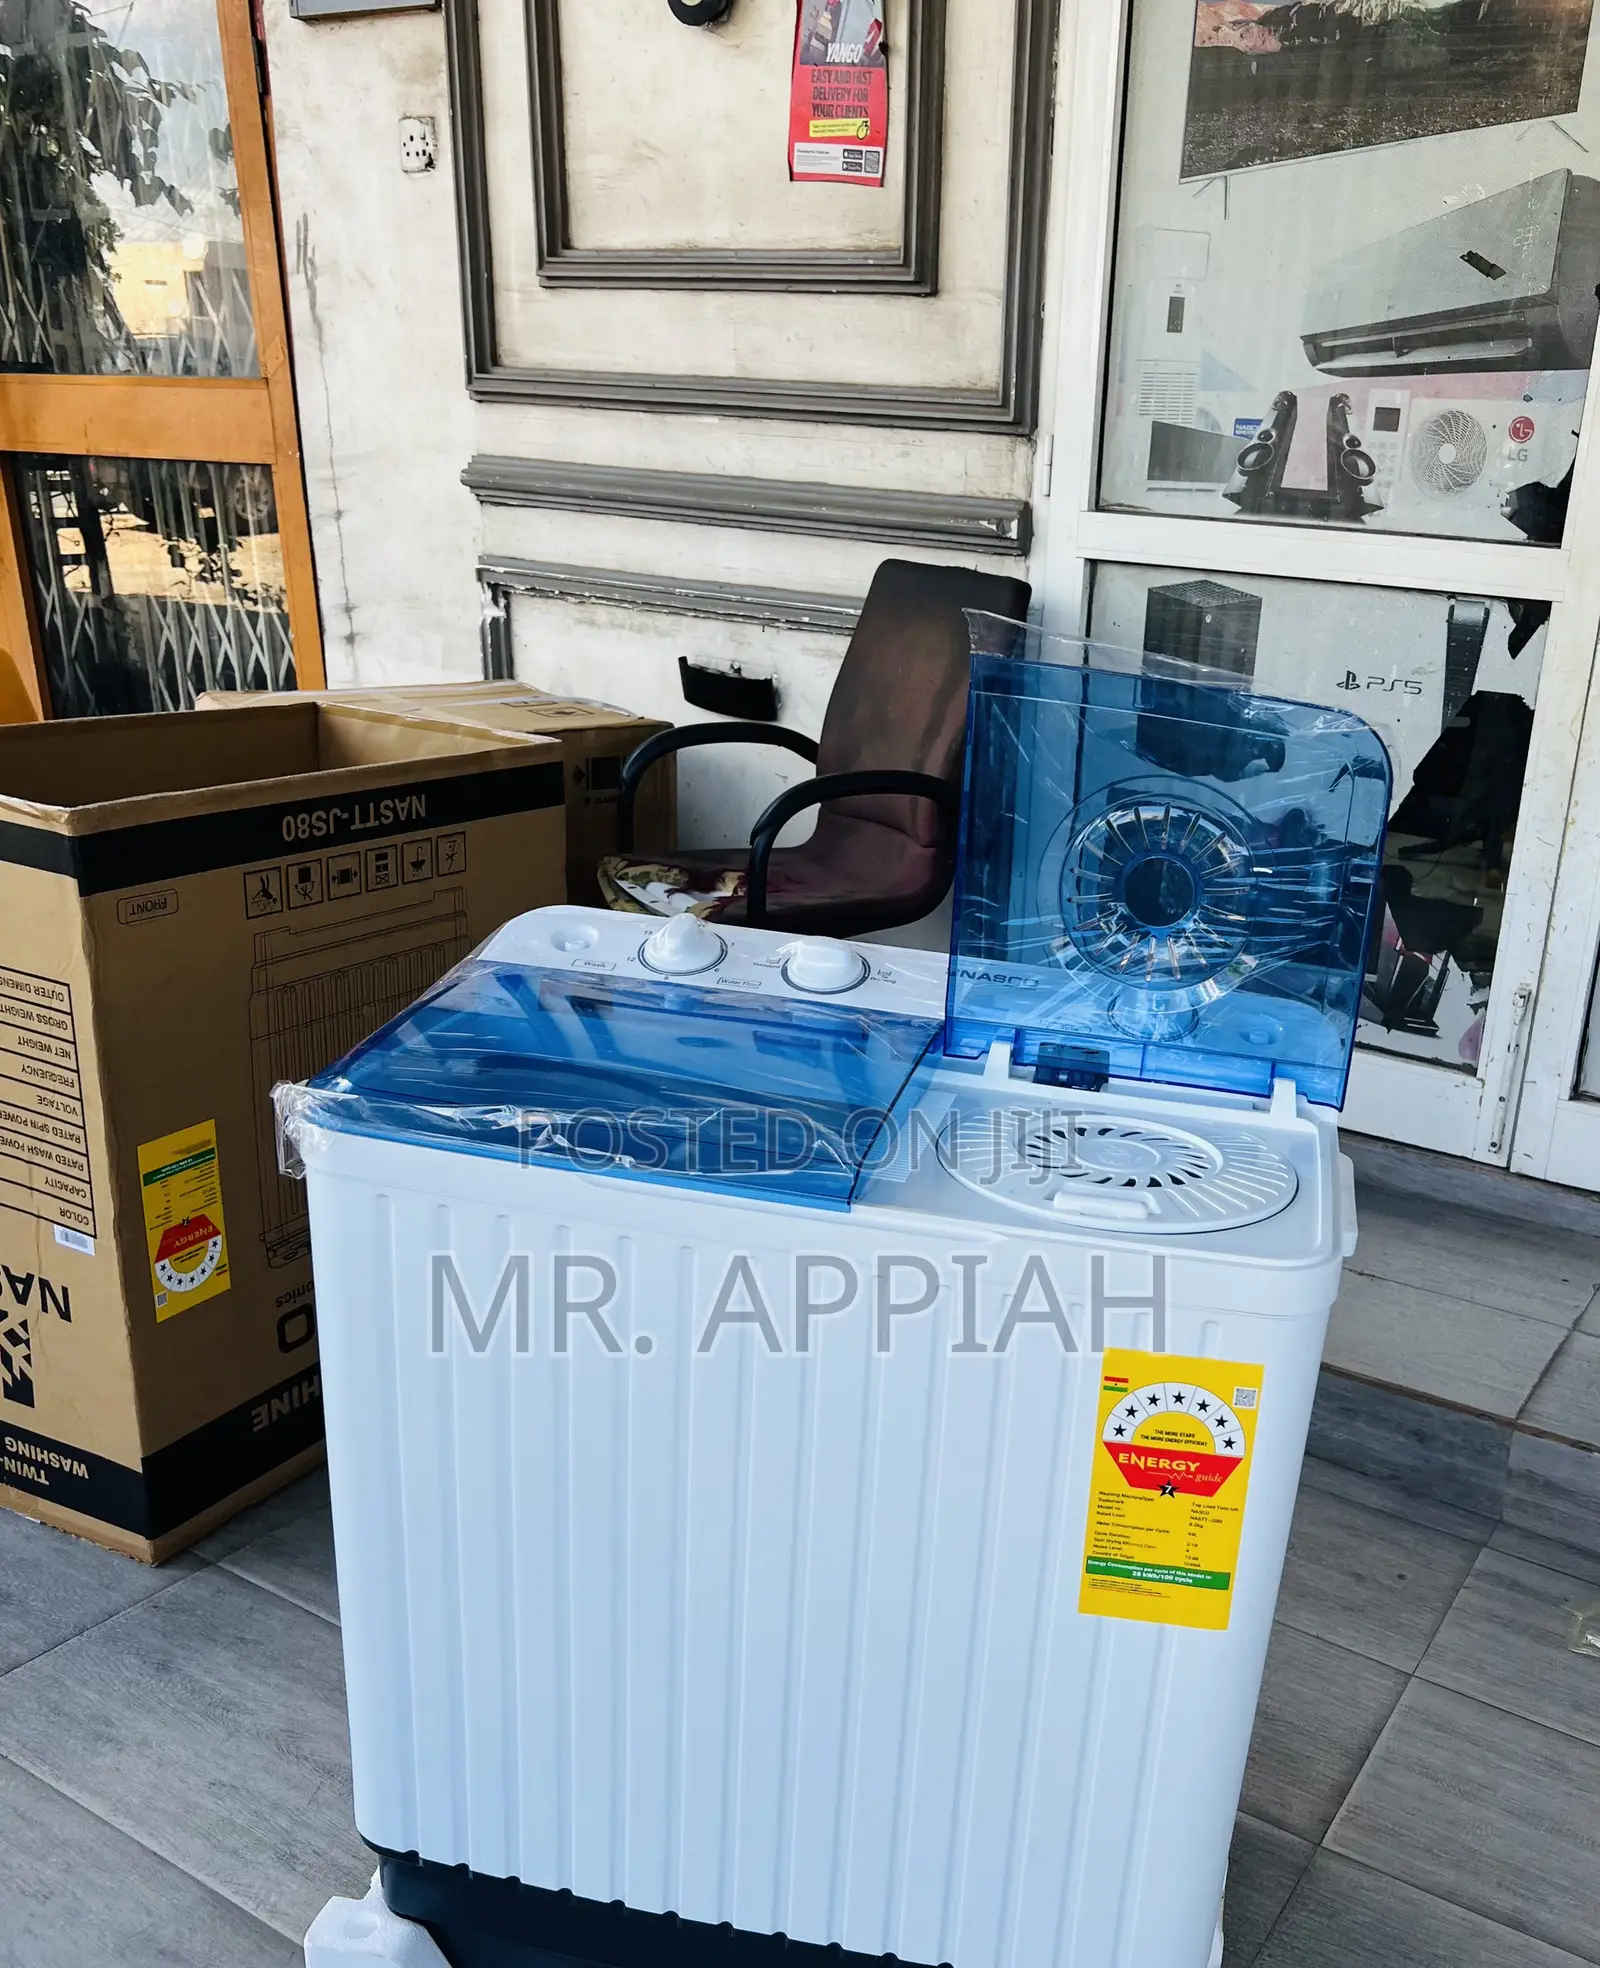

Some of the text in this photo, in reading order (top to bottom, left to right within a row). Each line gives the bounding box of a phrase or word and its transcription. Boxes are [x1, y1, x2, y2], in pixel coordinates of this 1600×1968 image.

[825, 43, 863, 63] YANGO
[811, 70, 873, 85] EASY AND FAST
[812, 87, 869, 102] DELIVERY FOR
[812, 104, 868, 118] YOUR CLIENTS
[1508, 448, 1528, 461] LG
[1367, 676, 1423, 695] PS5
[282, 795, 426, 841] NASTT-JS80
[129, 897, 168, 916] FRONT
[721, 978, 741, 986] Water
[959, 969, 1040, 987] NASCO
[34, 986, 65, 1002] OUTER
[0, 1004, 68, 1031] GROSS WEIGHT
[18, 1036, 72, 1060] NET WEIGHT
[21, 1064, 75, 1088] FREQUENCY
[37, 1095, 78, 1116] VOLTAGE
[31, 1119, 50, 1134] SPIN
[52, 1126, 81, 1144] RATED
[27, 1146, 53, 1160] WASH
[55, 1156, 84, 1171] RATED
[45, 1177, 87, 1199] CAPACITY
[59, 1207, 90, 1226] COLOR
[174, 1225, 213, 1249] ENERGY
[0, 1264, 73, 1323] NA
[251, 1374, 321, 1433] HINE
[1184, 1439, 1207, 1447] EFFICIENT
[4, 1436, 89, 1479] WASHING
[1118, 1451, 1200, 1473] ENERGY
[1195, 1472, 1223, 1483] guide
[1164, 1485, 1172, 1493] 7
[1112, 1522, 1145, 1531] Consumption
[1107, 1562, 1143, 1570] Consumption
[1143, 1572, 1174, 1580] kWh/100
[1174, 1576, 1193, 1584] cycle
